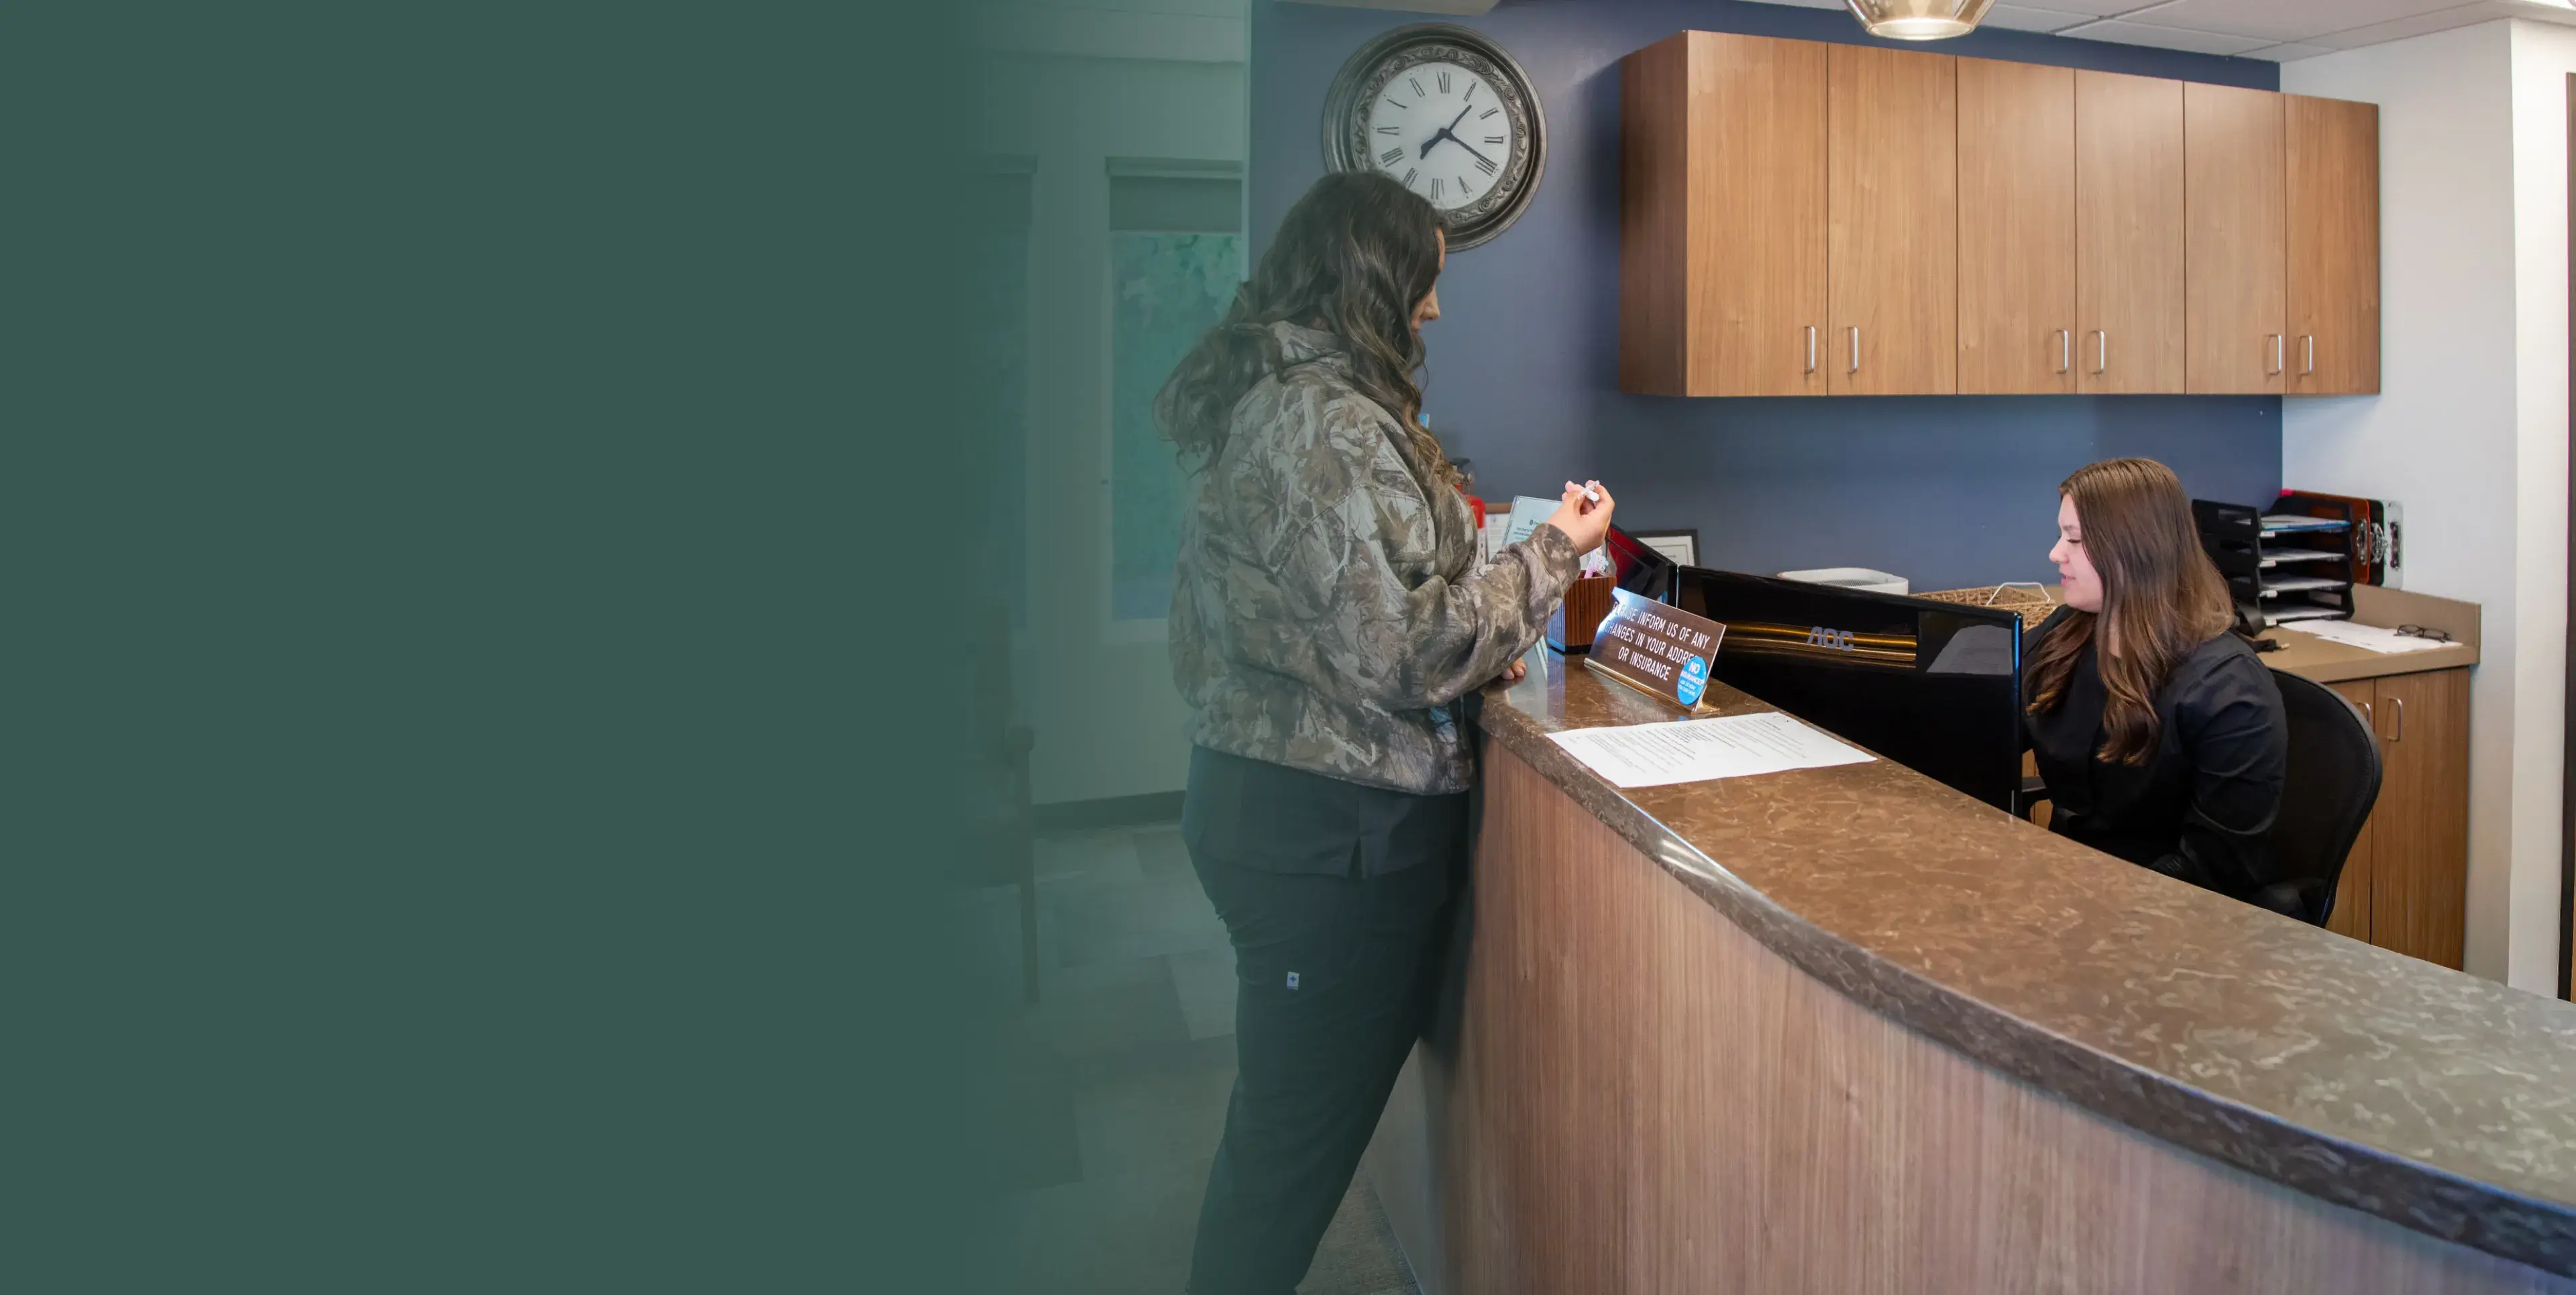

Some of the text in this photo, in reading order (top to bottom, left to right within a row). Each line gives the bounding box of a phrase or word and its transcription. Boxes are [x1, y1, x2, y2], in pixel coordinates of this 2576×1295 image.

[1604, 620, 1698, 666] CHANGES IN YOUR ADDRE
[1611, 601, 1711, 650] PLEASE INFORM US OF ANY
[1807, 626, 1854, 652] AOC
[1618, 645, 1672, 681] OR INSURANCE
[1688, 661, 1701, 674] NO
